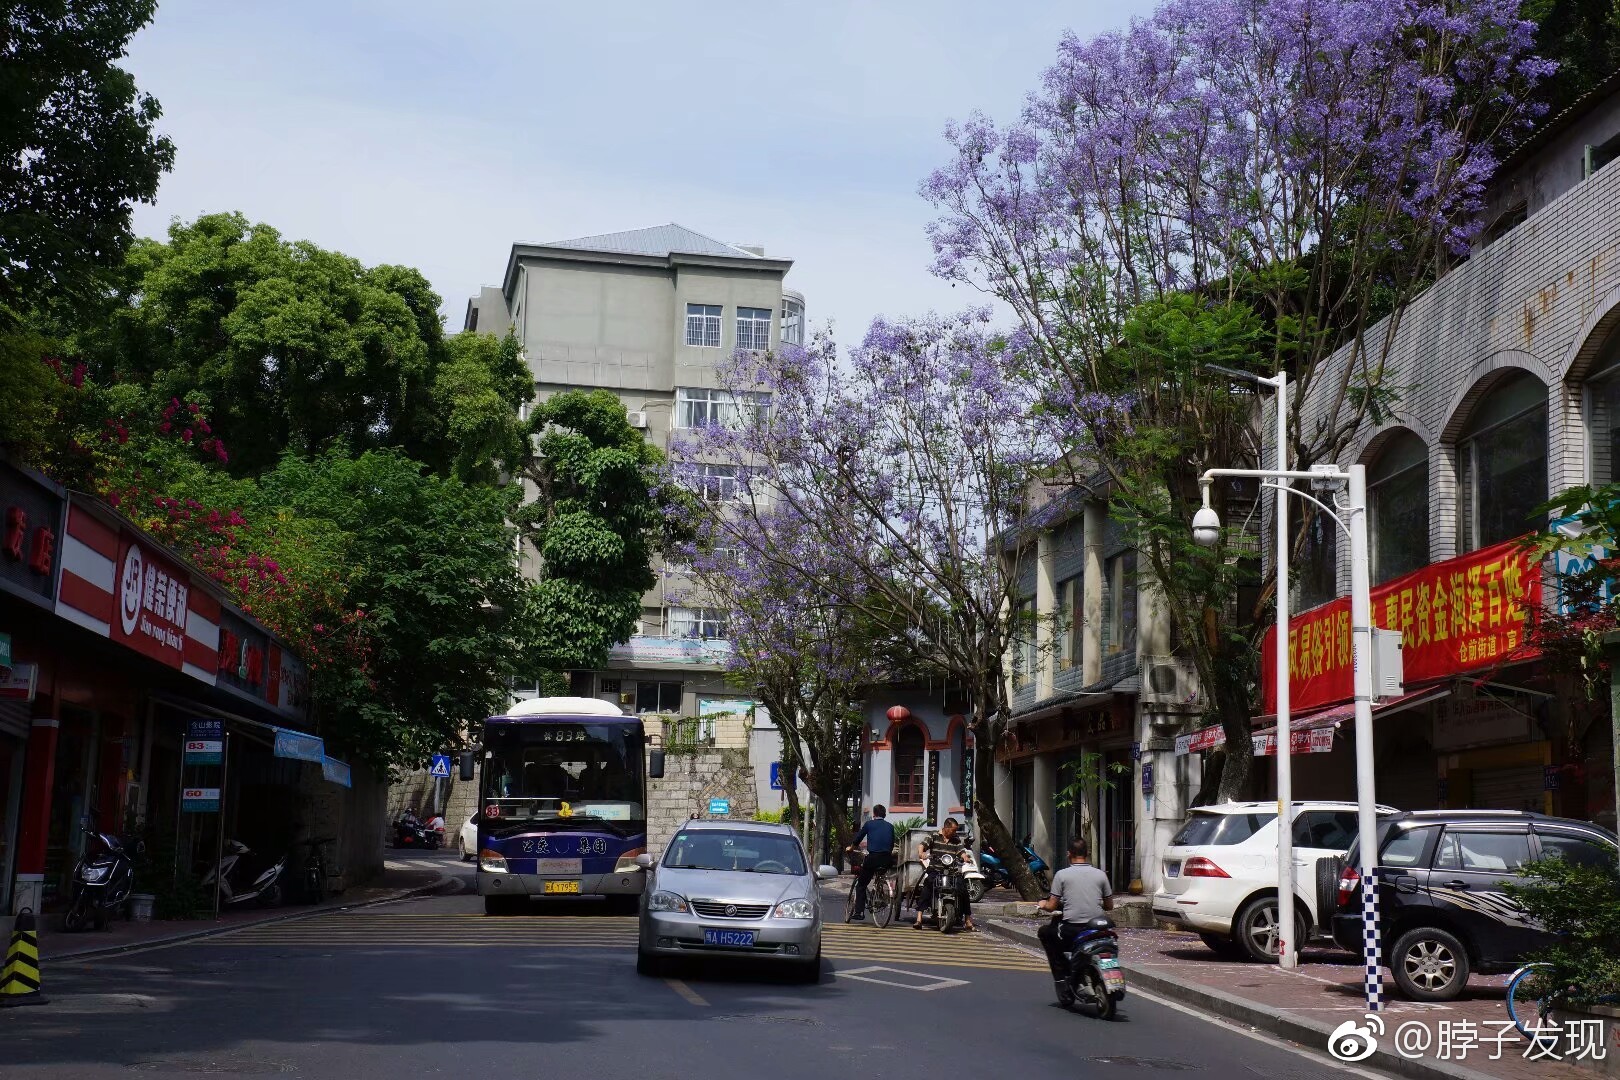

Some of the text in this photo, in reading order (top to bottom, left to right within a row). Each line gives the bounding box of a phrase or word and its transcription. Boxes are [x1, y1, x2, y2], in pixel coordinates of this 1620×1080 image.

[1459, 634, 1497, 663] 仓前街道
[188, 742, 205, 750] 83
[486, 806, 498, 817] 83
[523, 837, 606, 854] 公交 集团
